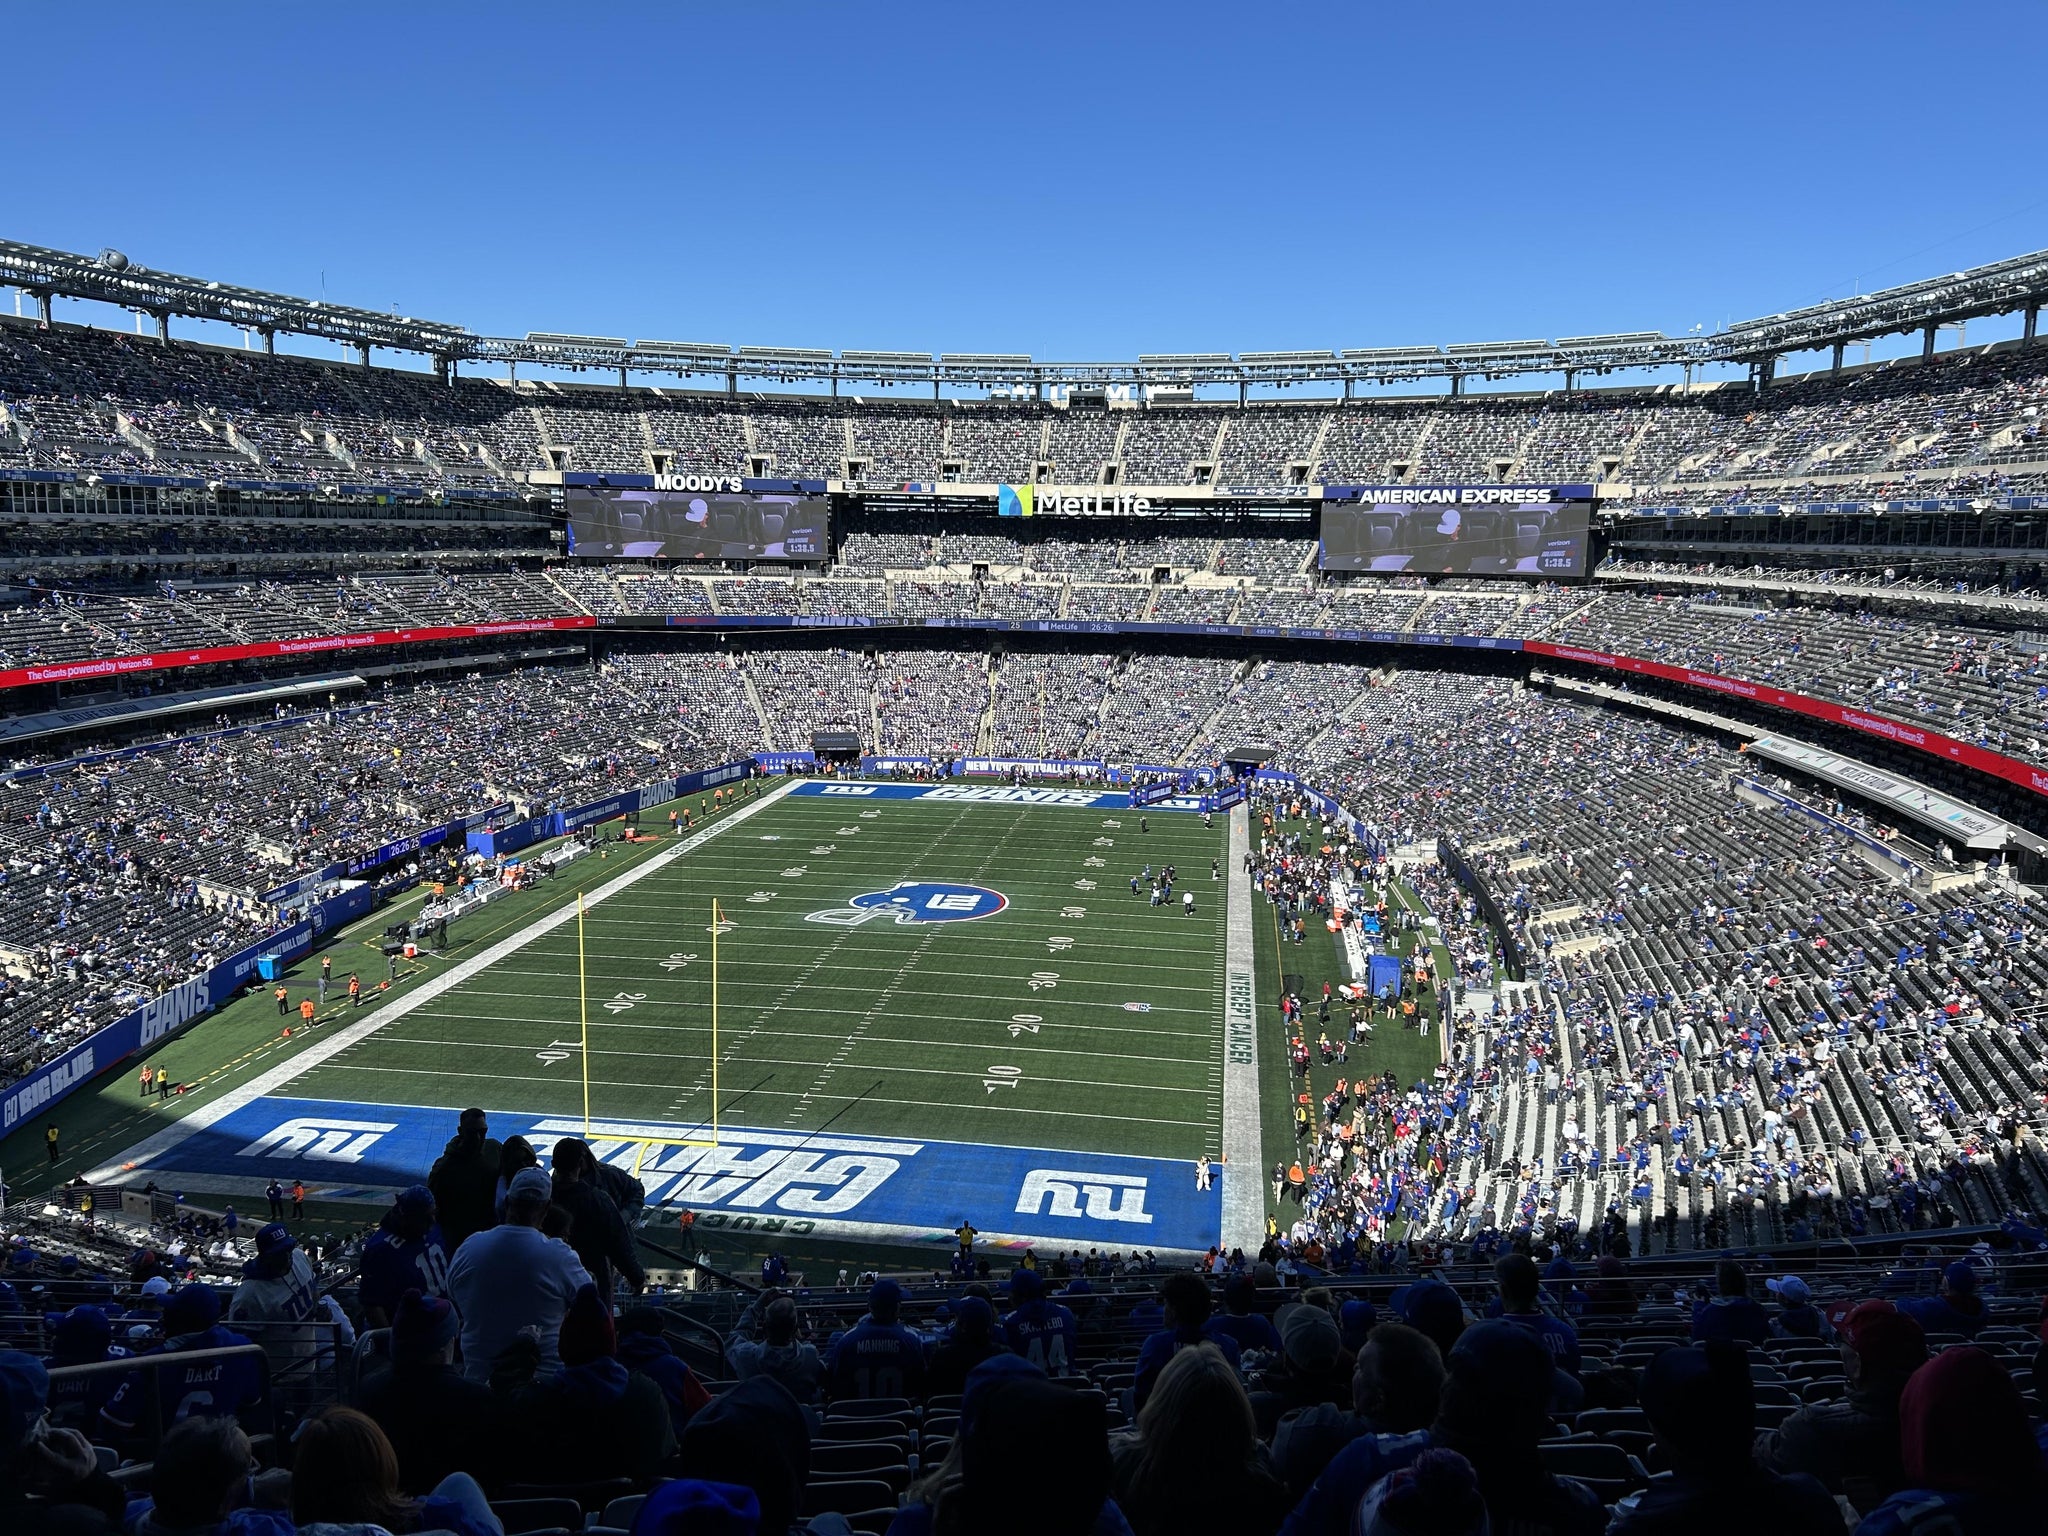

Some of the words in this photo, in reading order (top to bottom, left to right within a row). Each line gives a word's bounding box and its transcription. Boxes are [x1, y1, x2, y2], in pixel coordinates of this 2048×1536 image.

[654, 474, 742, 492] MOODY'S
[1037, 490, 1150, 516] MetLife
[1360, 489, 1457, 504] AMERICAN
[1461, 489, 1551, 504] EXPRESS
[1544, 558, 1572, 568] 1:38.5
[1010, 622, 1021, 630] 25
[1050, 622, 1078, 631] MetLife
[1091, 623, 1113, 632] 26:26
[290, 642, 309, 651] Giants
[309, 639, 338, 650] powered
[338, 638, 346, 647] by
[27, 671, 42, 681] The
[43, 669, 66, 678] Giants
[68, 664, 105, 677] powered
[106, 662, 116, 673] by
[117, 659, 143, 669] Verizon
[143, 658, 153, 666] 5G
[1727, 682, 1734, 692] by
[1841, 711, 1850, 722] The
[1864, 718, 1888, 734] powered
[1888, 722, 1896, 737] by
[1897, 727, 1916, 742] Verizon
[1916, 733, 1924, 745] 5G
[966, 760, 990, 771] NEW
[1121, 766, 1132, 774] 25
[2032, 772, 2042, 786] The
[639, 779, 676, 810] GIANTS
[921, 787, 1103, 804] GIANTS
[1961, 816, 1987, 831] MetLife
[390, 840, 410, 857] 26:26
[410, 837, 420, 849] 25
[361, 852, 365, 862] 0
[350, 865, 359, 874] NYG
[746, 891, 778, 903] 50
[1060, 906, 1087, 918] 50
[1046, 936, 1075, 950] 40
[235, 958, 250, 978] NEW
[658, 953, 698, 967] 30
[1028, 972, 1060, 988] 30
[603, 992, 646, 1009] 20
[1230, 972, 1251, 1019] INTERCEPT
[140, 971, 210, 1047] GIANTS
[1007, 1014, 1043, 1033] 20
[535, 1040, 584, 1060] 10
[1229, 1023, 1252, 1065] CANCER
[983, 1065, 1022, 1088] 10
[4, 1094, 18, 1128] GO
[18, 1075, 50, 1117] BIG
[50, 1047, 94, 1096] BLUE
[1014, 1169, 1153, 1224] ny
[269, 1227, 286, 1241] ny
[415, 1243, 448, 1296] 10
[857, 1338, 900, 1354] MANNING
[1026, 1334, 1070, 1377] 44
[184, 1365, 223, 1384] DART
[853, 1366, 904, 1398] 10
[56, 1378, 90, 1393] DART
[113, 1381, 130, 1401] 6
